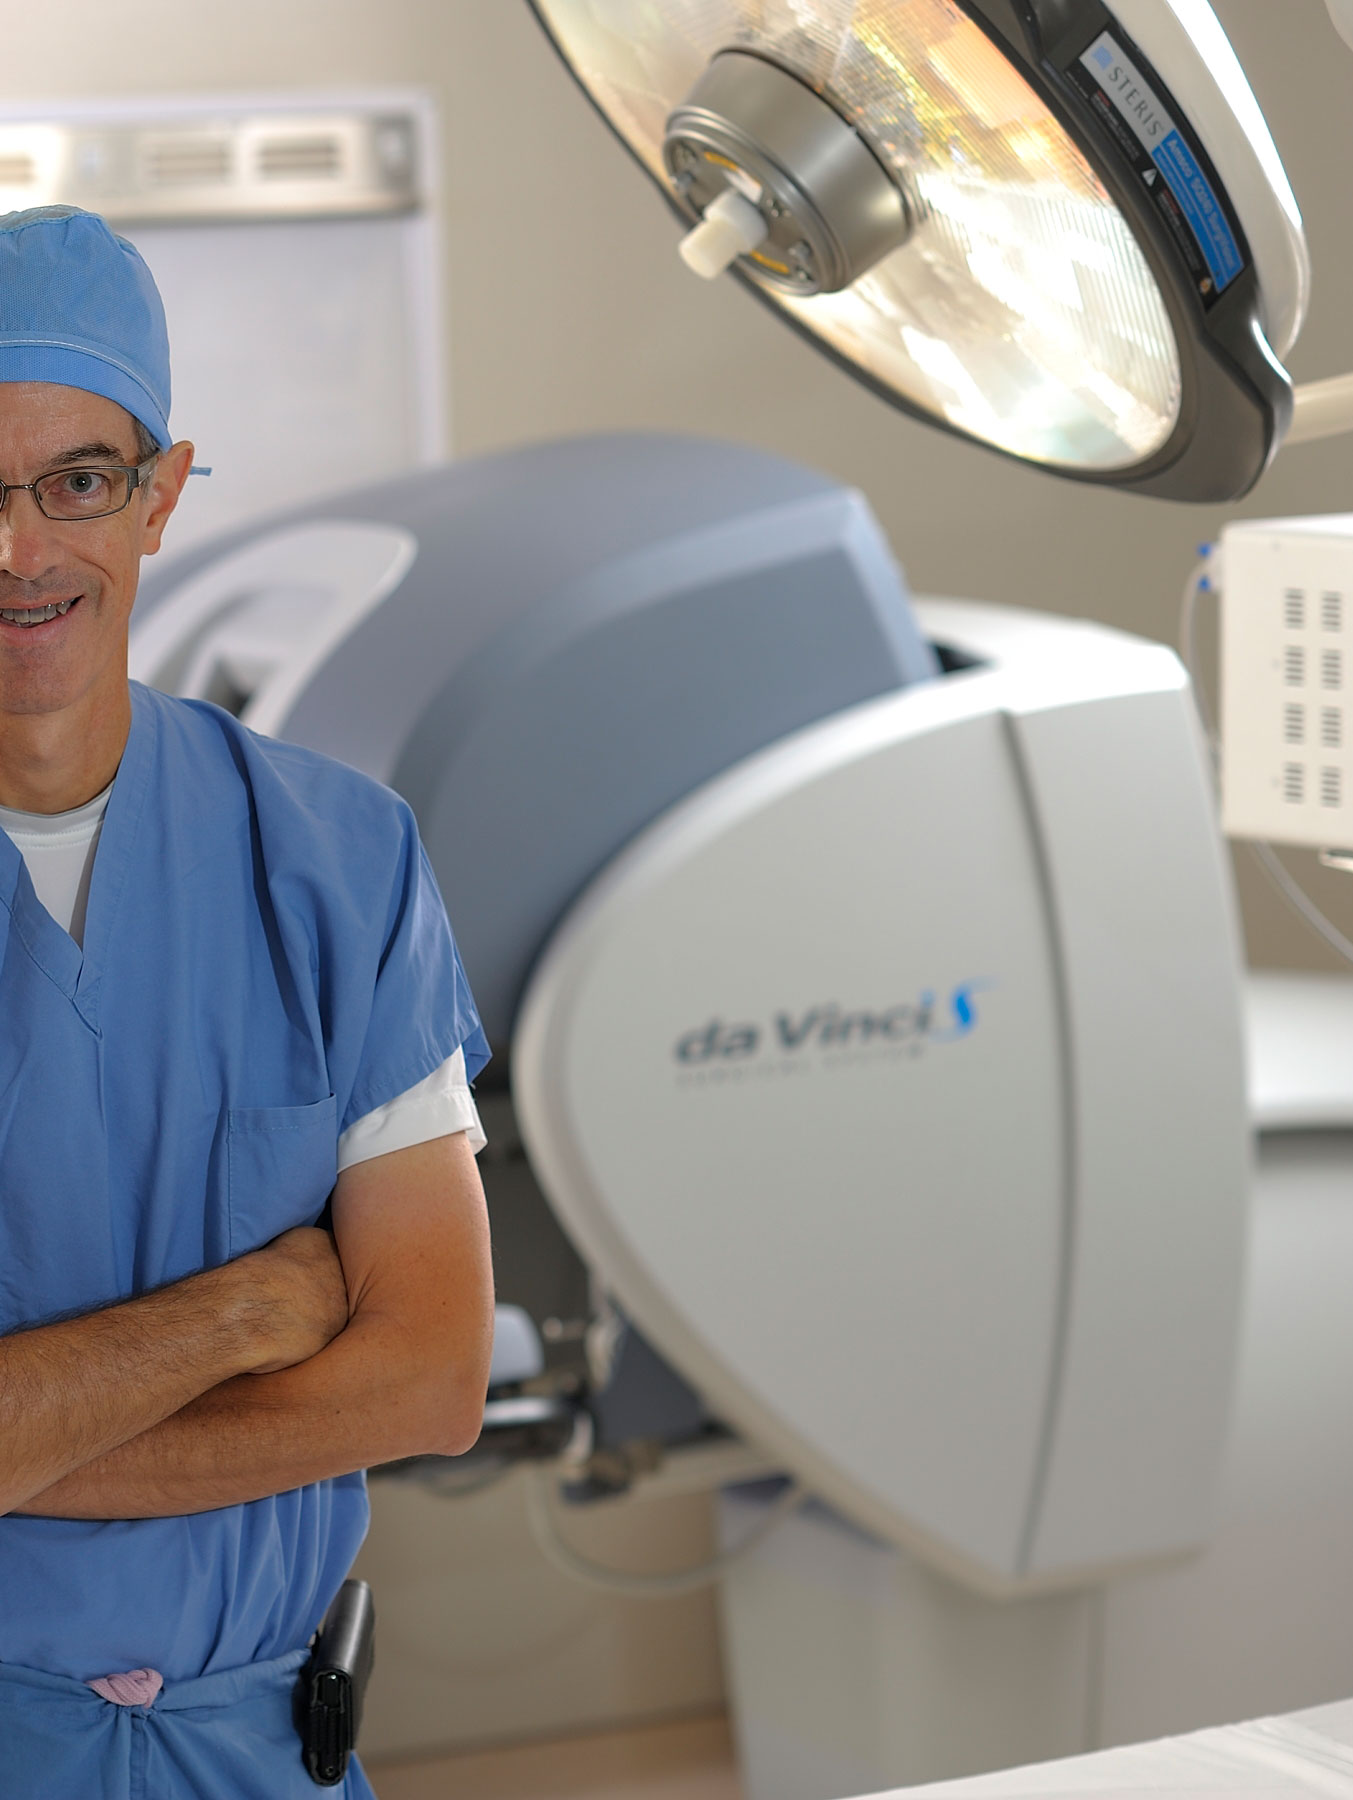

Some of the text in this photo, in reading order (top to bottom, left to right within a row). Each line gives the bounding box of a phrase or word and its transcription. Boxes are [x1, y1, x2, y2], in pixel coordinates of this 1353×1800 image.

[1109, 65, 1164, 137] STERIS
[676, 1018, 758, 1064] da
[776, 990, 934, 1049] Vinci
